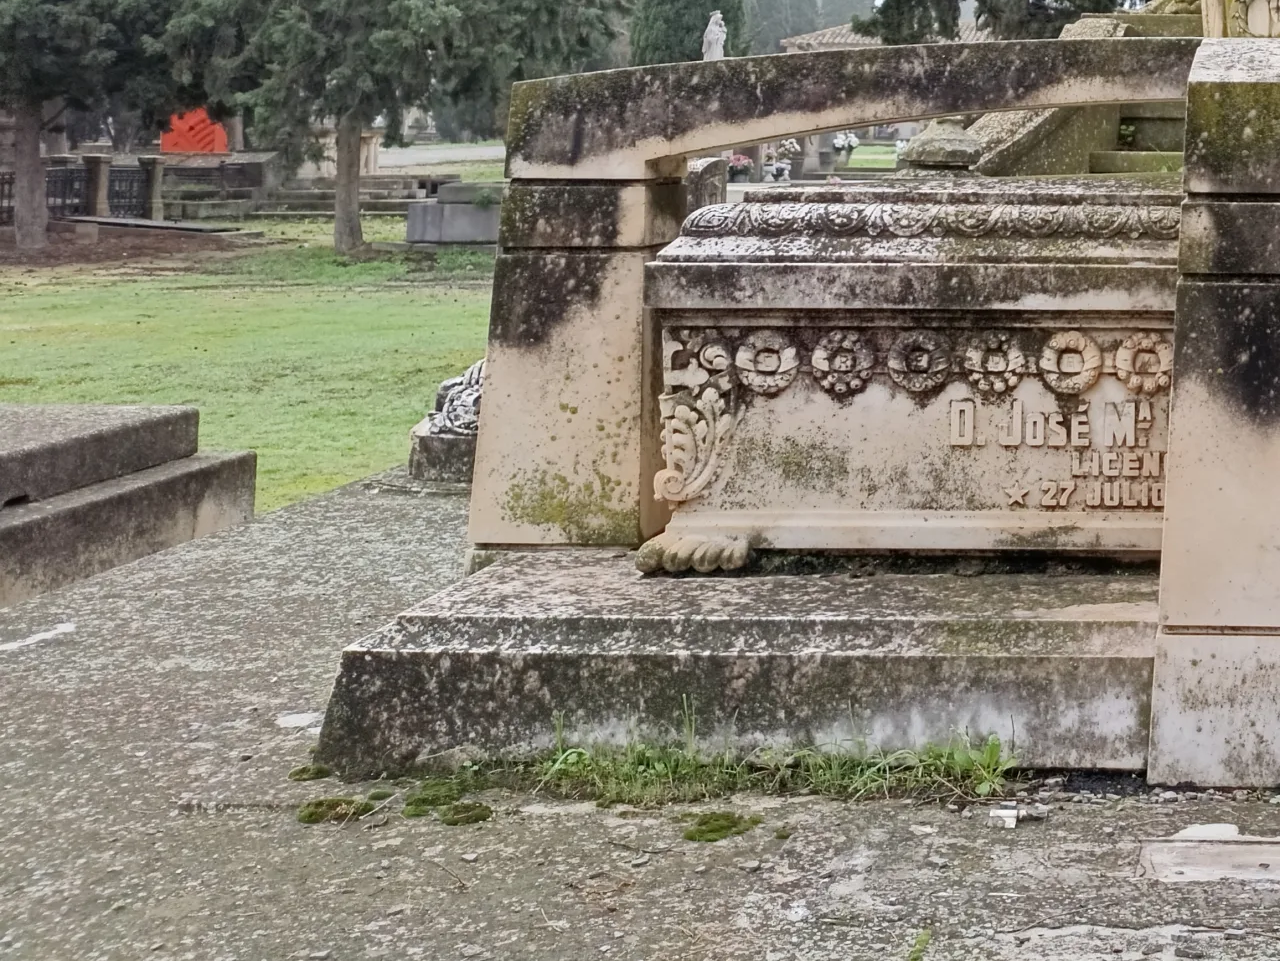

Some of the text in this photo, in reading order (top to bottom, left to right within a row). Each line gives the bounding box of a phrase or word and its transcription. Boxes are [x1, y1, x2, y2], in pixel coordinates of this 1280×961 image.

[951, 399, 985, 446] D.
[999, 400, 1090, 447] JOSÉ
[1072, 451, 1169, 477] LICEN
[1041, 482, 1076, 506] 27
[1086, 482, 1165, 507] JULIO
